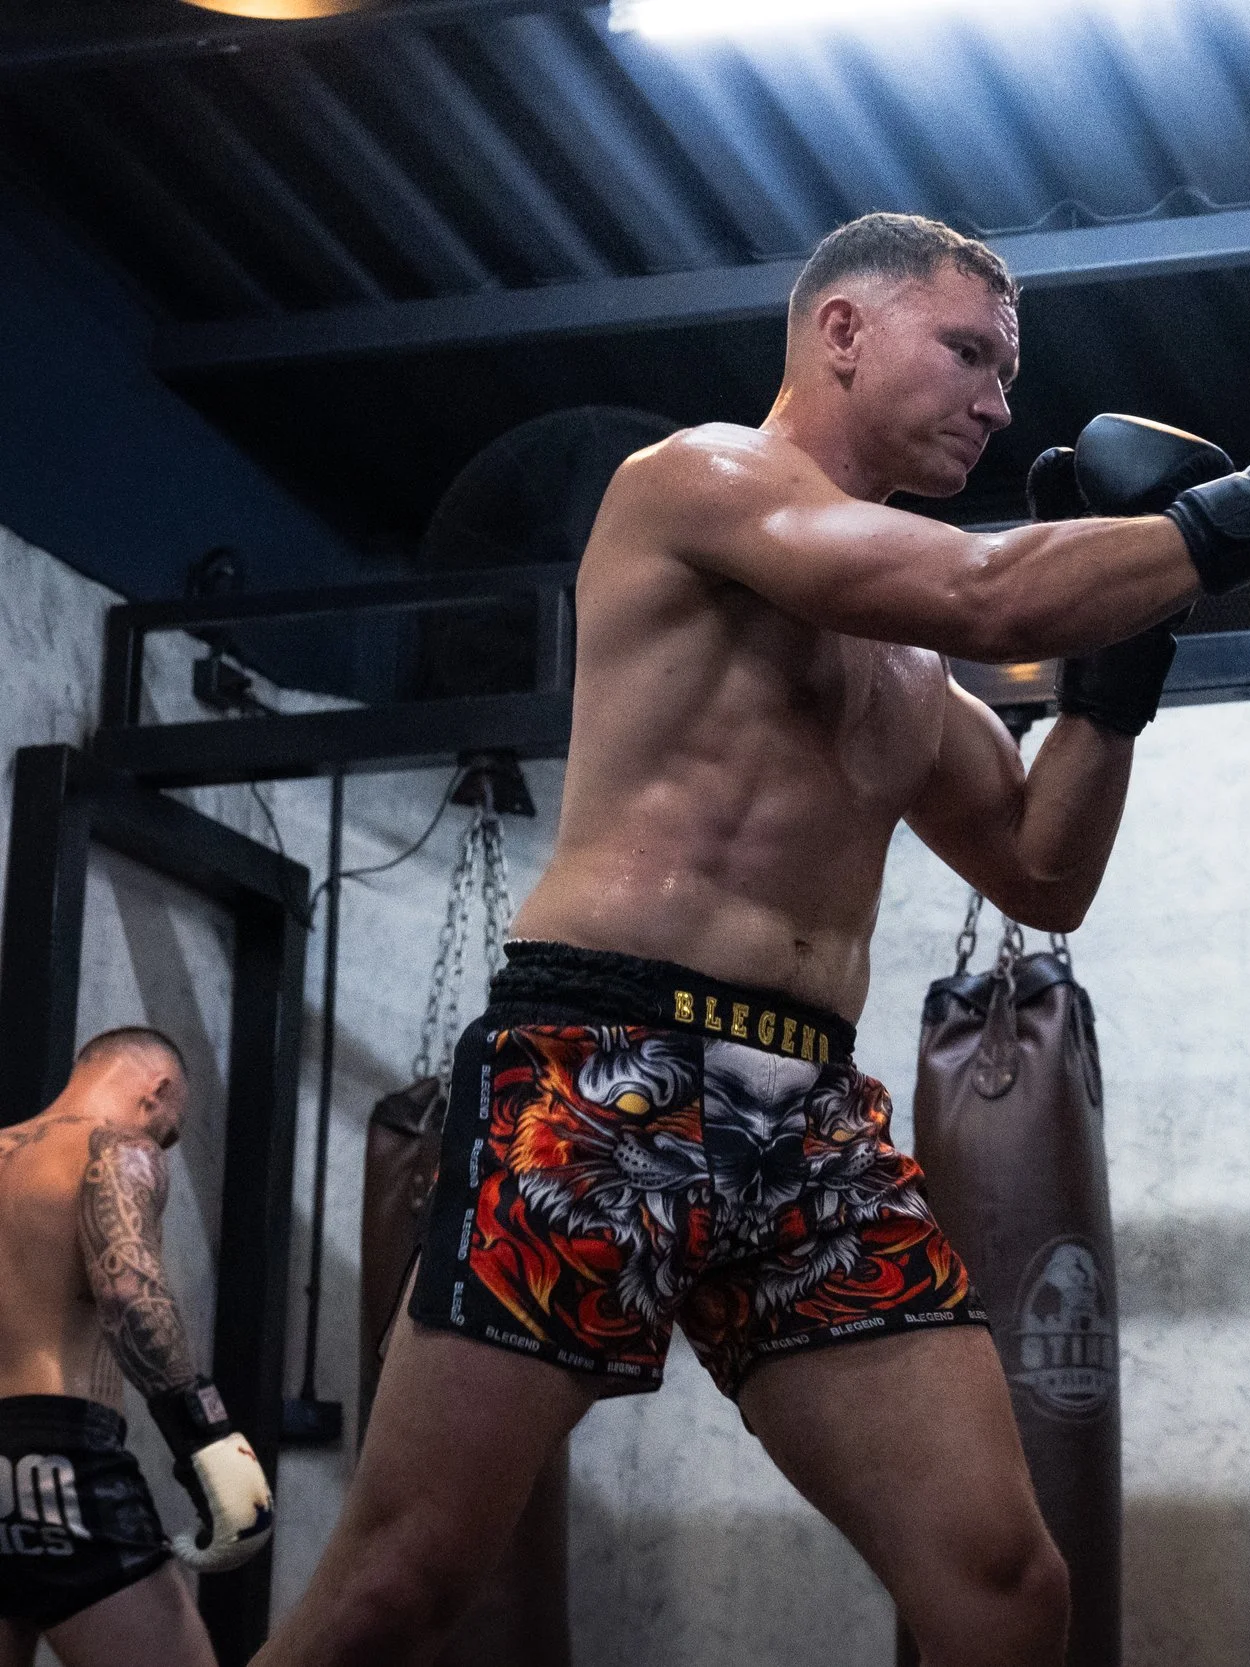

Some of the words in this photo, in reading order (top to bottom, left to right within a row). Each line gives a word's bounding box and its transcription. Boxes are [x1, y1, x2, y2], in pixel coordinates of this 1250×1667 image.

[674, 989, 829, 1065] BLEGEND
[829, 1317, 886, 1337] BLEGEND
[904, 1311, 955, 1323] BLEGEND
[485, 1324, 541, 1353] BLEGEND
